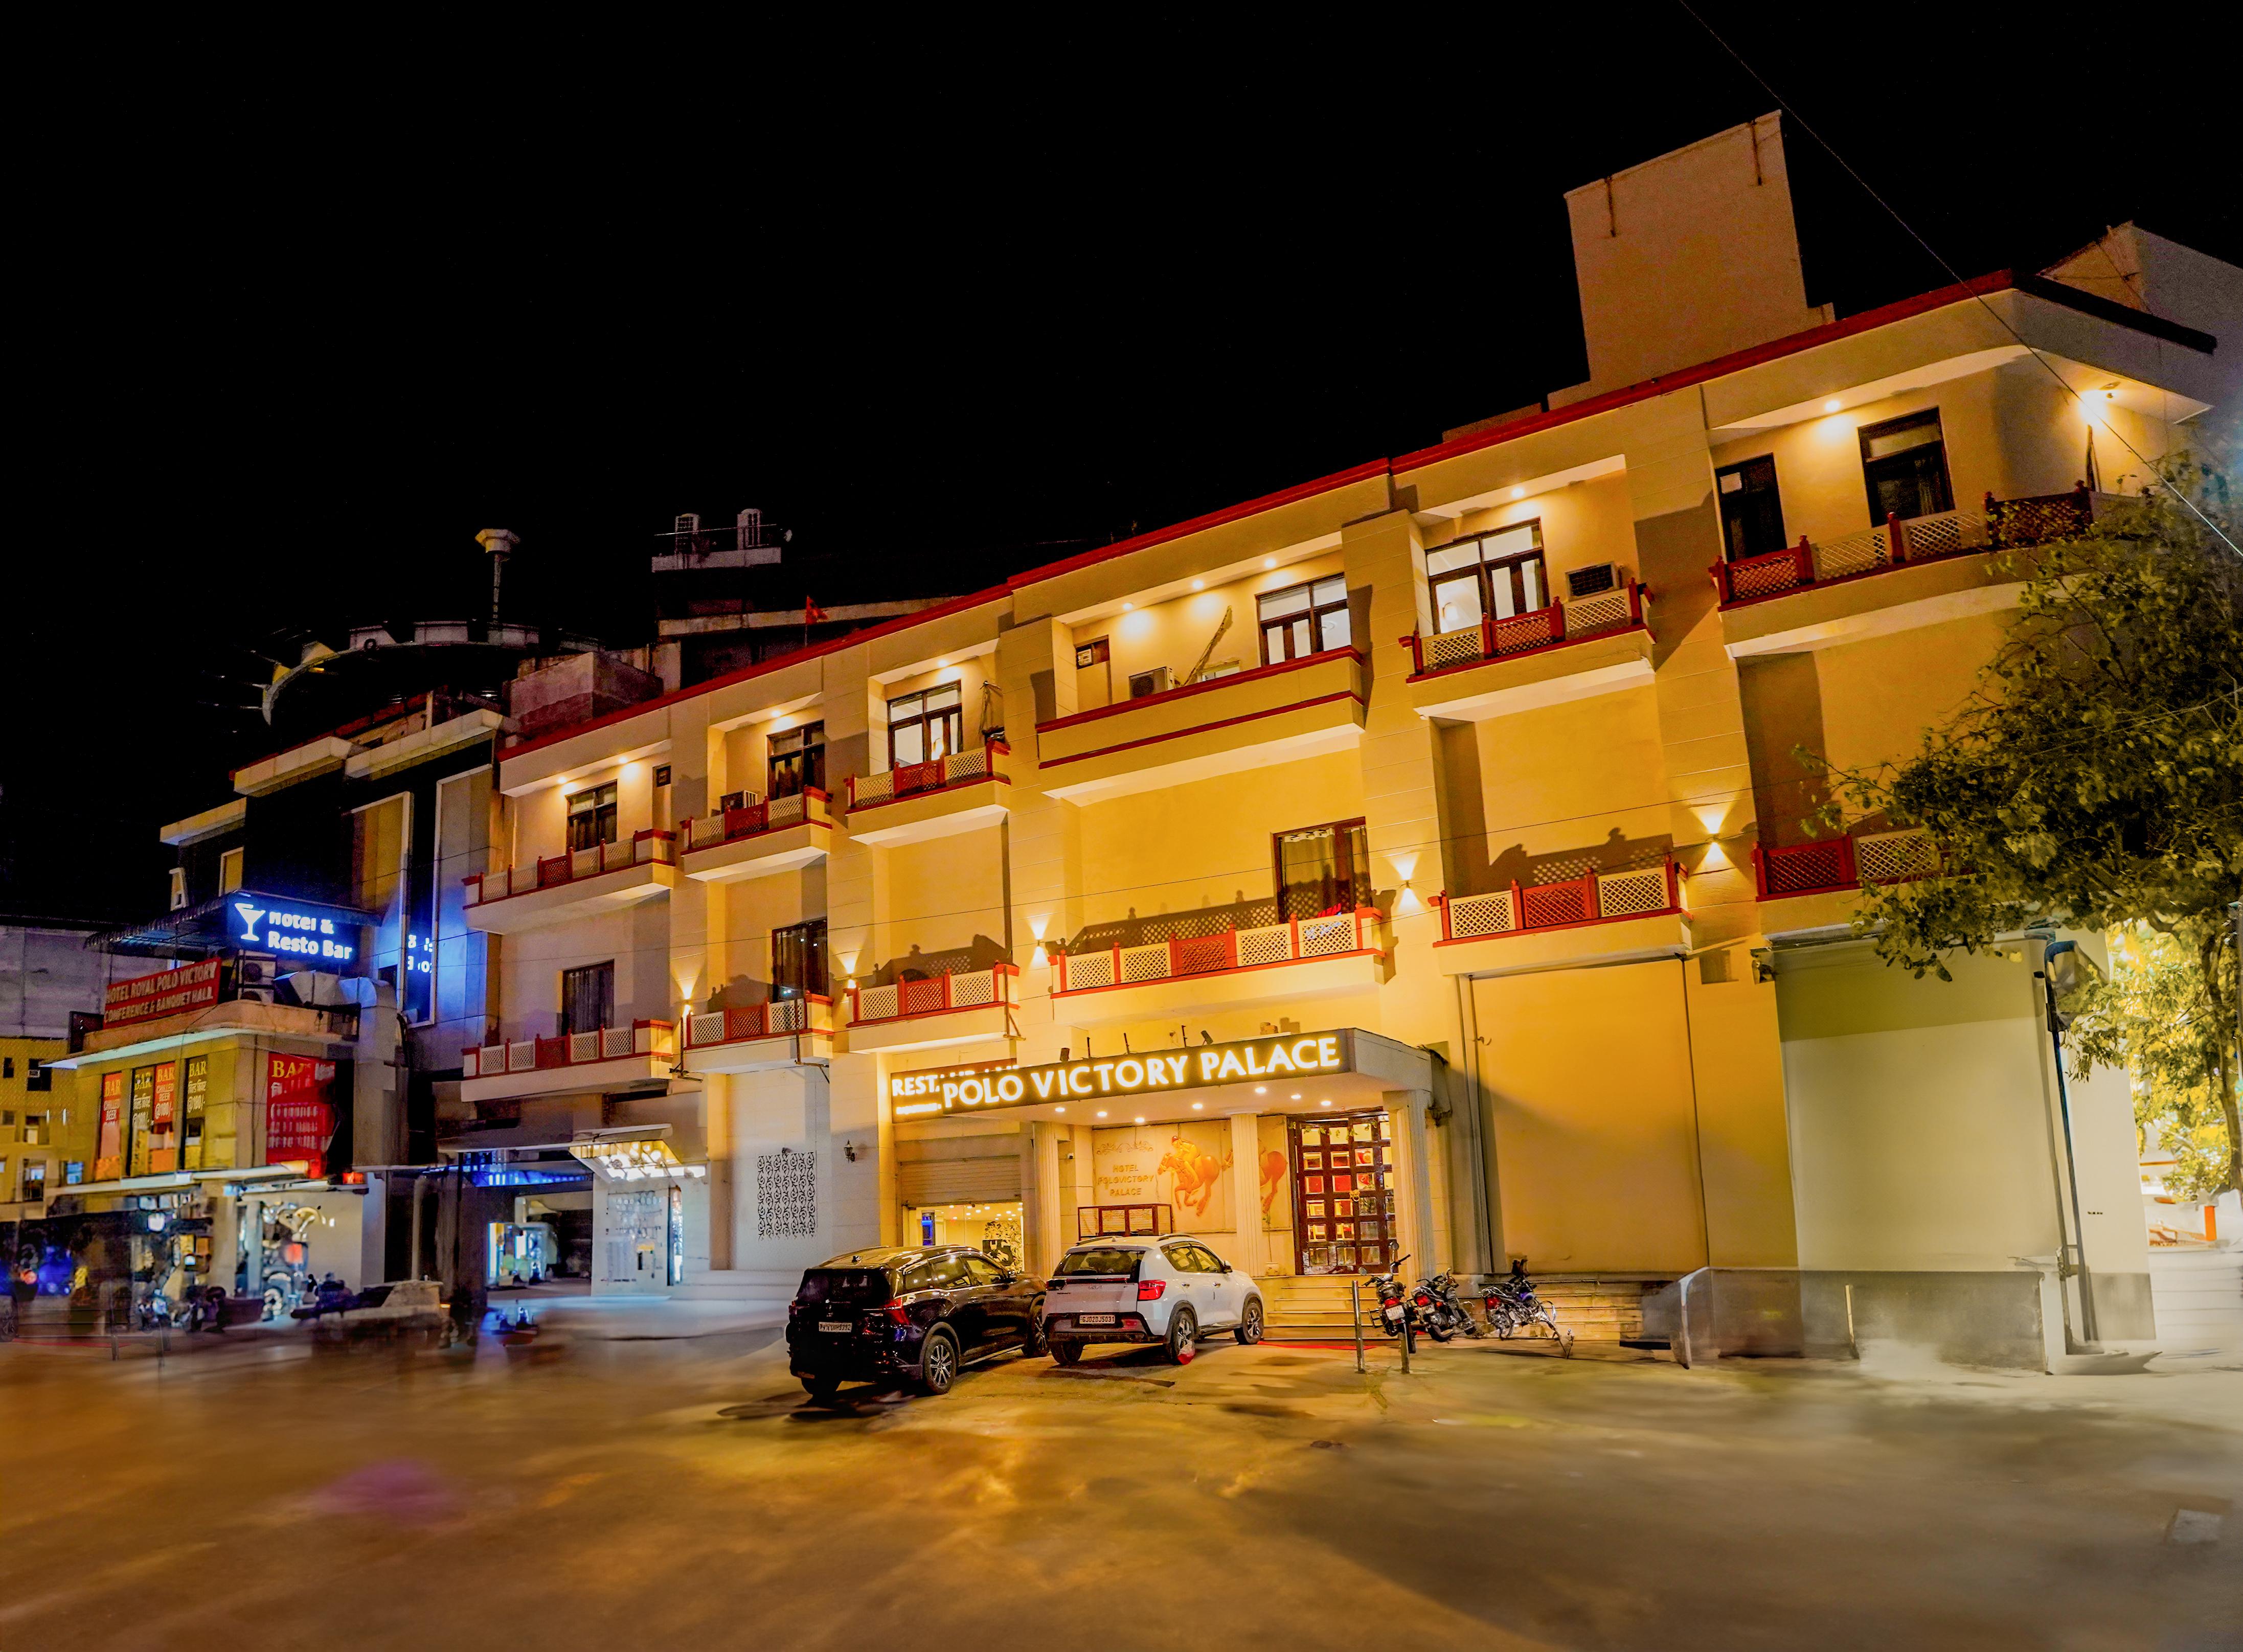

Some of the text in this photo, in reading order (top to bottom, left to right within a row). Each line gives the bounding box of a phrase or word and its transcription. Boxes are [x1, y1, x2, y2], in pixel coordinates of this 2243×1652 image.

[321, 919, 334, 934] &
[268, 931, 352, 959] Resto Bar
[106, 961, 217, 1004] HOTEL ROYAL POLO VICTORY
[104, 1000, 150, 1023] CONFERENCE
[156, 990, 192, 1013] BANQUET
[192, 985, 213, 1003] HALL
[157, 1066, 175, 1082] BAR
[189, 1061, 207, 1078] BAR
[942, 1037, 1340, 1108] POLO VICTORY PALACE
[104, 1079, 121, 1097] BAR
[1113, 1164, 1139, 1173] HOTEL
[1109, 1188, 1142, 1196] PALACE
